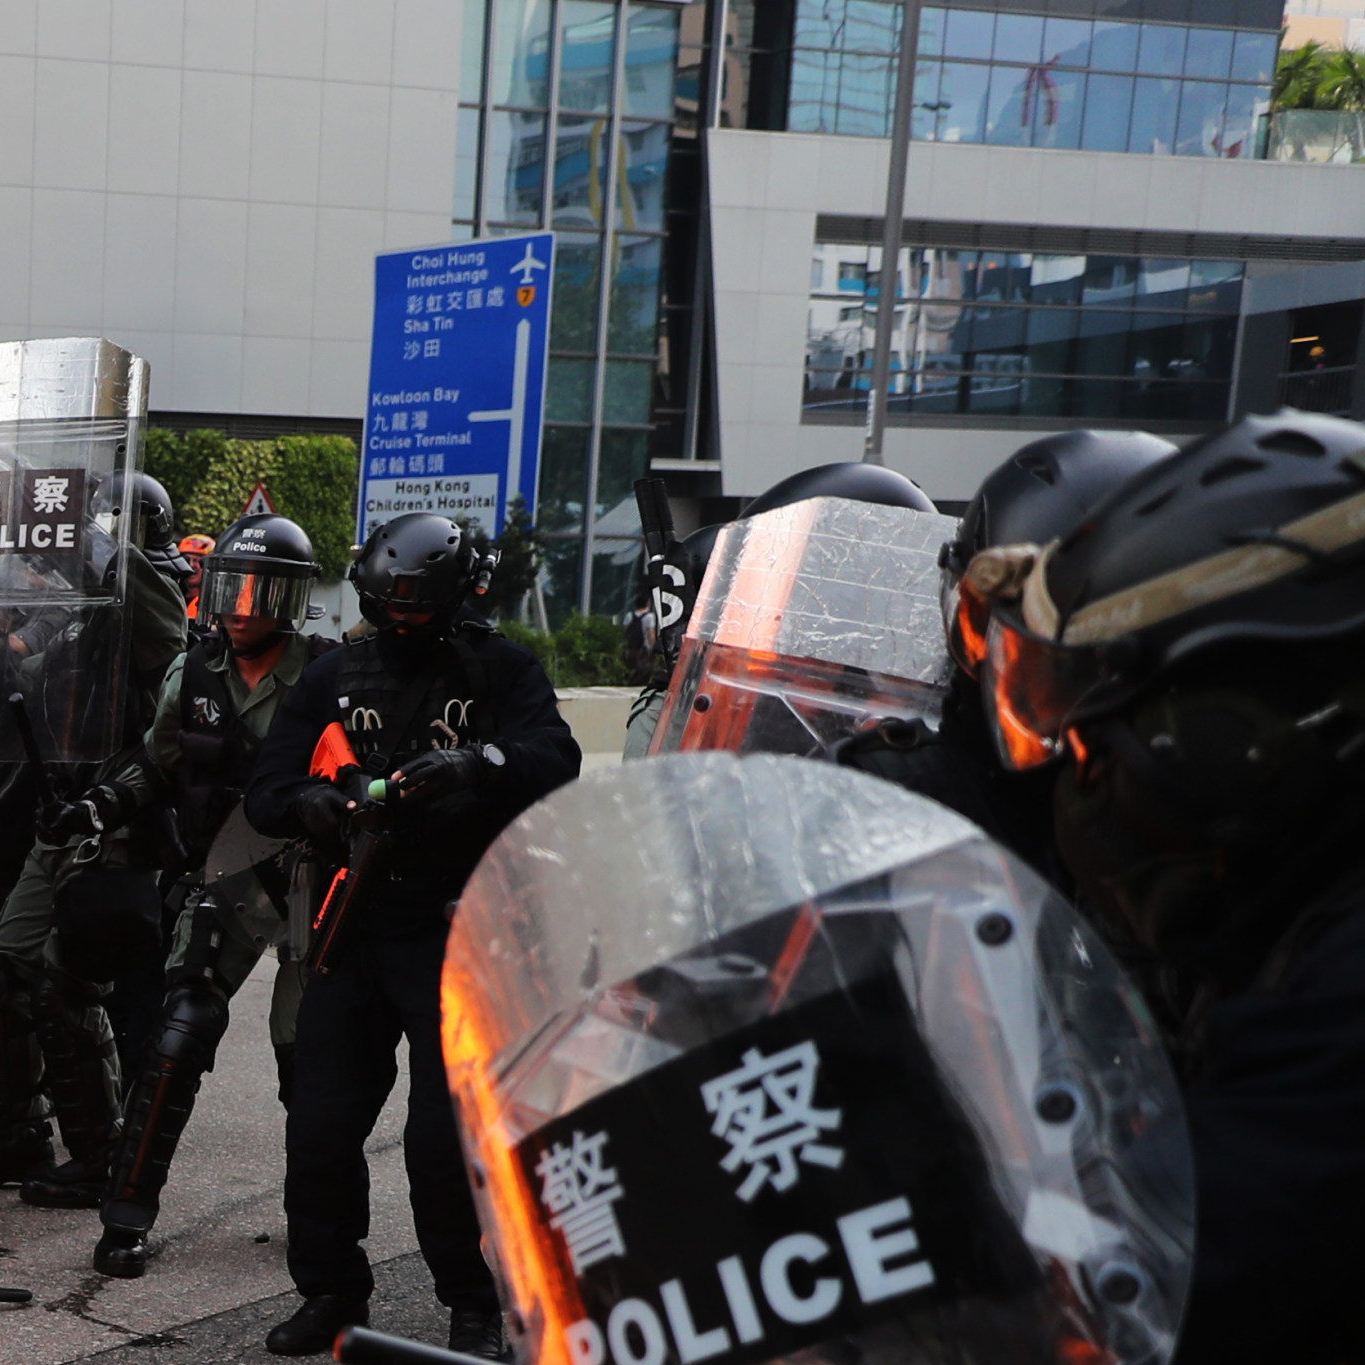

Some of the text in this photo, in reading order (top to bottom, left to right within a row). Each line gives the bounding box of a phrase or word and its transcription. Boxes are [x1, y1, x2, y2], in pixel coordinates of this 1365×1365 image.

[412, 252, 485, 270] Choi Hung
[407, 269, 488, 289] Interchange
[406, 286, 504, 315] 彩虹交匯處
[522, 288, 530, 303] 7
[404, 316, 454, 334] Sha Tin
[403, 339, 440, 360] 沙田
[372, 387, 460, 406] Kowloon Bay
[372, 410, 428, 432] 九龍灣
[369, 430, 471, 450] Cruise Terminal
[395, 480, 470, 495] Hong Kong
[366, 495, 495, 512] Children's Hospital
[233, 542, 266, 553] Police
